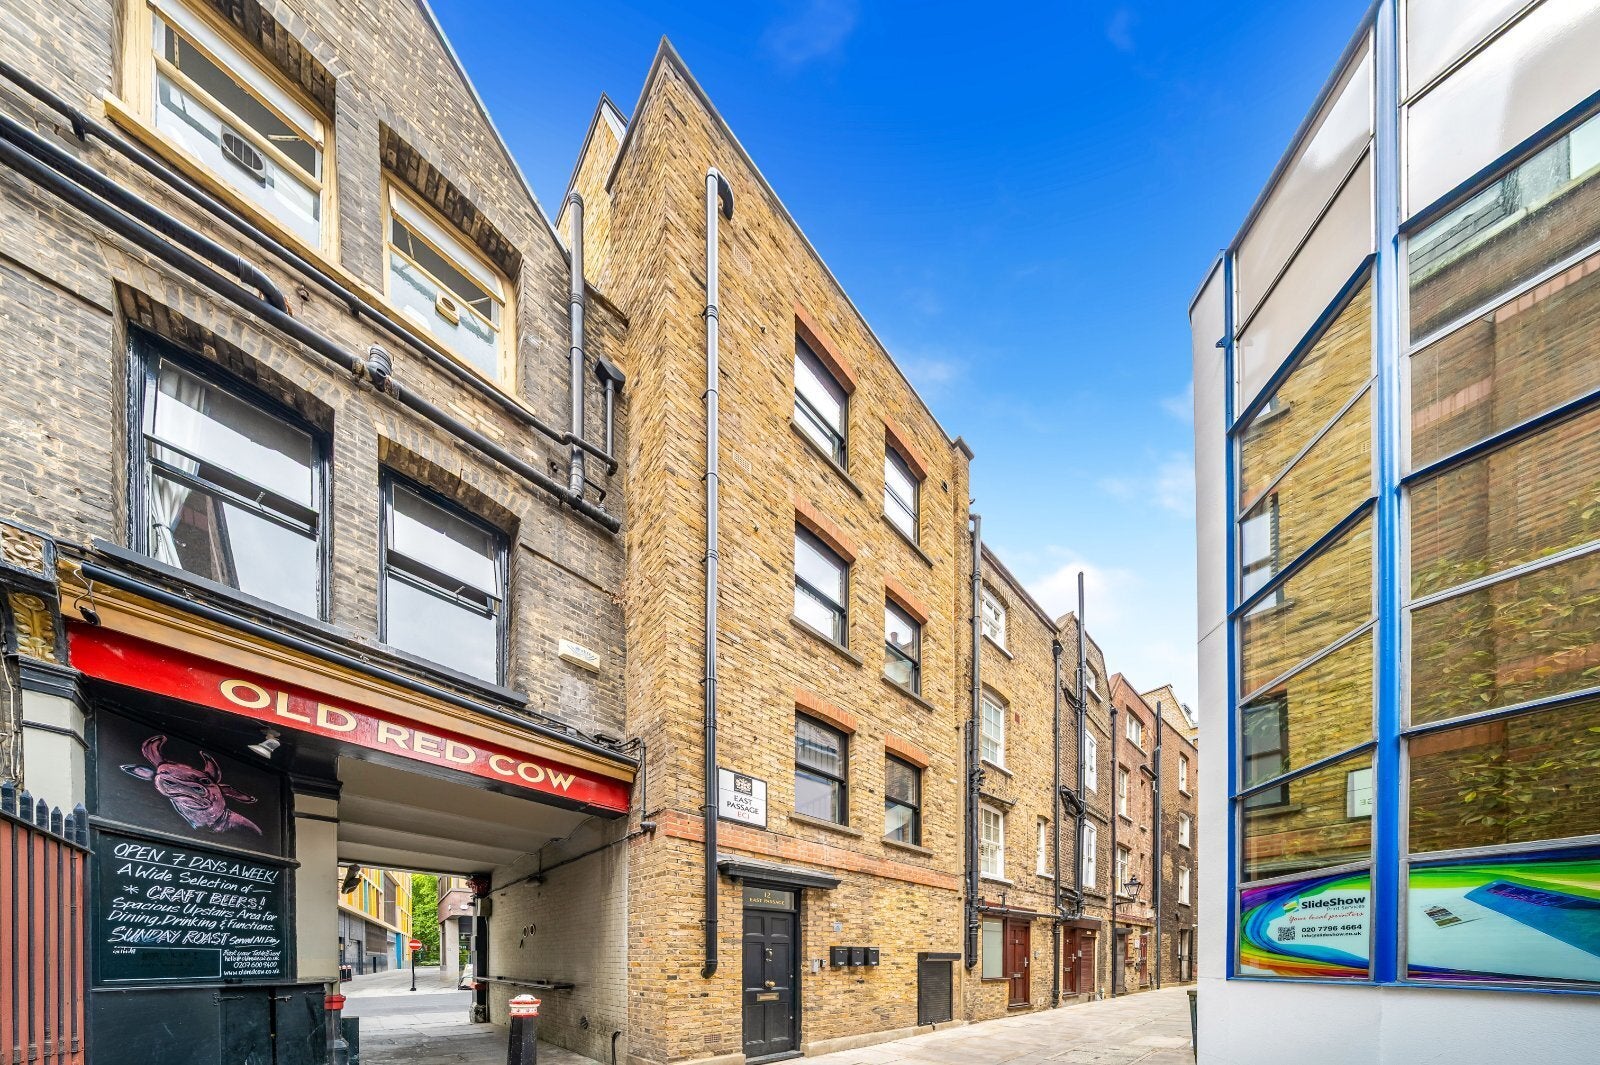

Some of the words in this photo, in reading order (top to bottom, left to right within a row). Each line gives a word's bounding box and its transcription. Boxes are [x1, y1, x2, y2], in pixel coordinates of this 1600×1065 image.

[219, 678, 358, 733] OLD
[377, 720, 477, 765] RED
[488, 754, 577, 792] COW
[734, 794, 752, 806] EAST
[726, 800, 760, 815] PASSAGE
[737, 811, 750, 820] EC1
[114, 843, 165, 862] OPEN
[172, 853, 186, 866] 7
[189, 856, 227, 872] DAYS
[229, 864, 240, 875] A
[242, 866, 279, 882] WEEK!
[117, 863, 132, 877] A
[135, 865, 173, 881] Wide
[179, 871, 238, 891] Selection
[241, 884, 254, 894] of
[146, 886, 208, 905] CRAFT
[209, 892, 266, 910] BEERS!
[763, 898, 785, 906] PASSAGE
[764, 891, 771, 899] 12
[113, 897, 181, 913] Spacious
[183, 903, 235, 918] Upstairs
[237, 909, 261, 921] Area
[263, 911, 278, 921] for
[1301, 896, 1366, 910] SlideShow
[227, 918, 275, 931] Functions.
[1289, 915, 1307, 924] Your
[1308, 912, 1327, 920] local
[1327, 911, 1364, 921] printers
[107, 926, 182, 944] SUNDAY
[182, 931, 230, 945] ROAST
